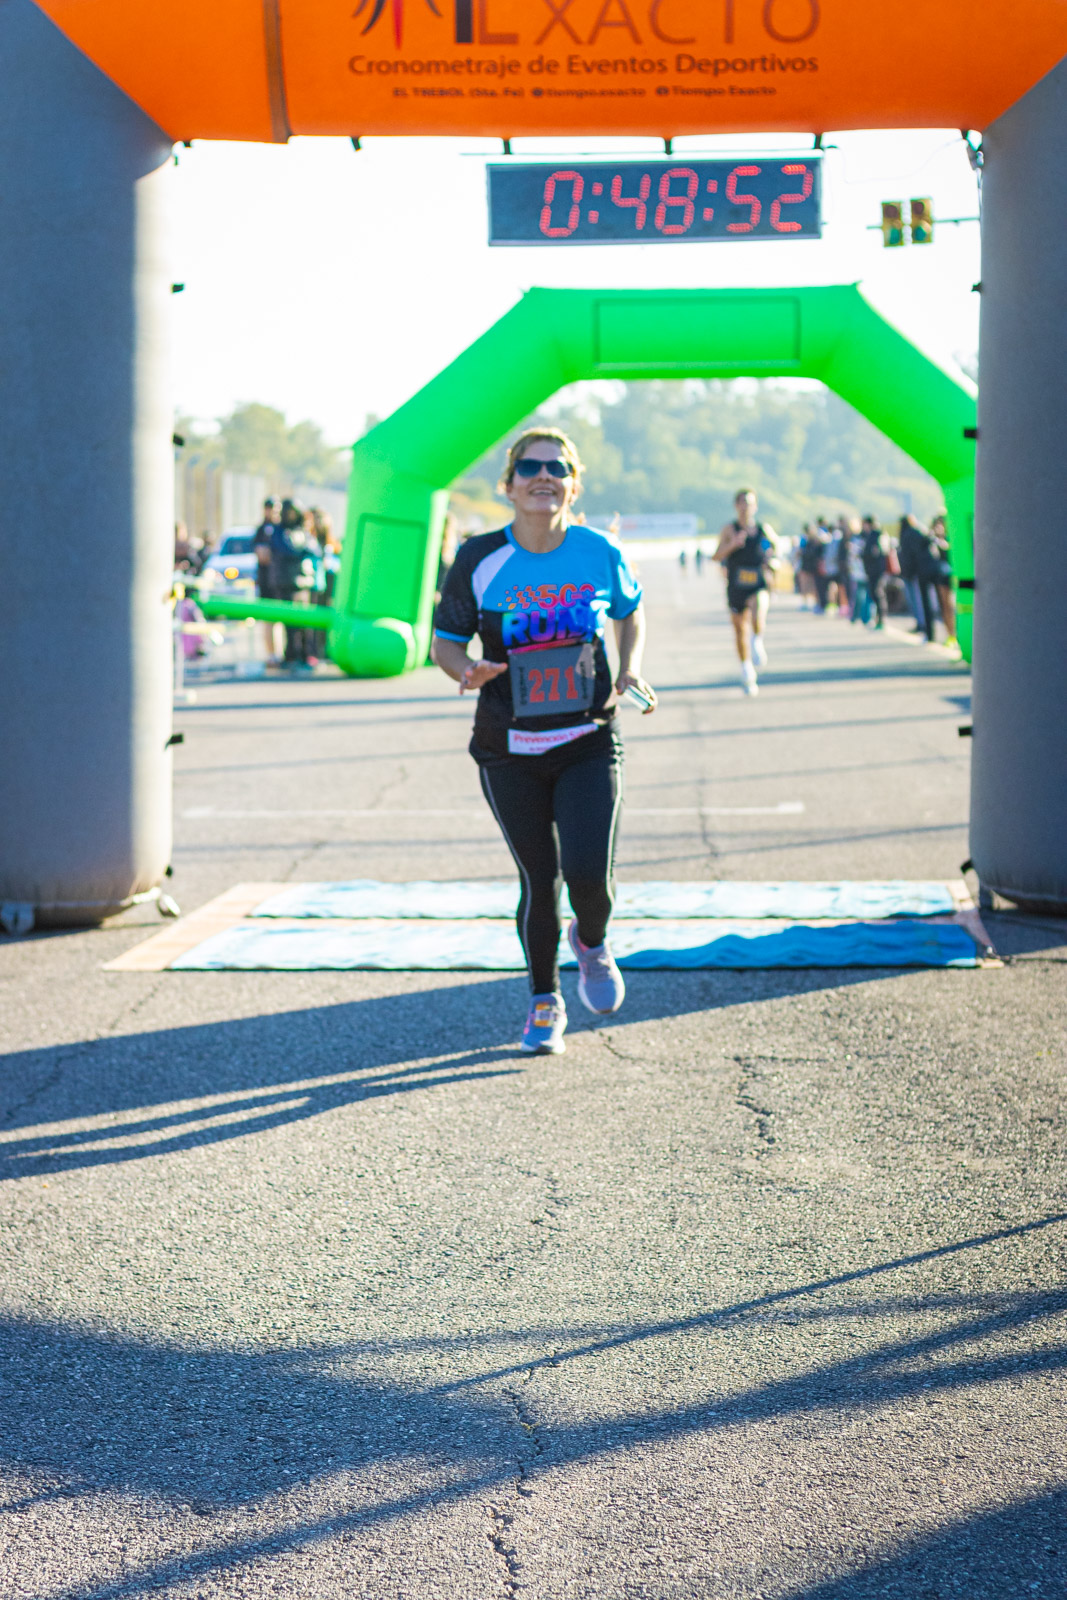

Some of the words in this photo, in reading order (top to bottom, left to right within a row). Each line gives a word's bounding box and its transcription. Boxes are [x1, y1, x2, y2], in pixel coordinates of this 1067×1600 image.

[349, 55, 521, 79] Cronometraje
[527, 55, 560, 75] de
[567, 54, 668, 76] Eventos
[675, 53, 819, 77] Deportivos
[540, 164, 814, 238] 0:48:52
[528, 666, 579, 703] 271
